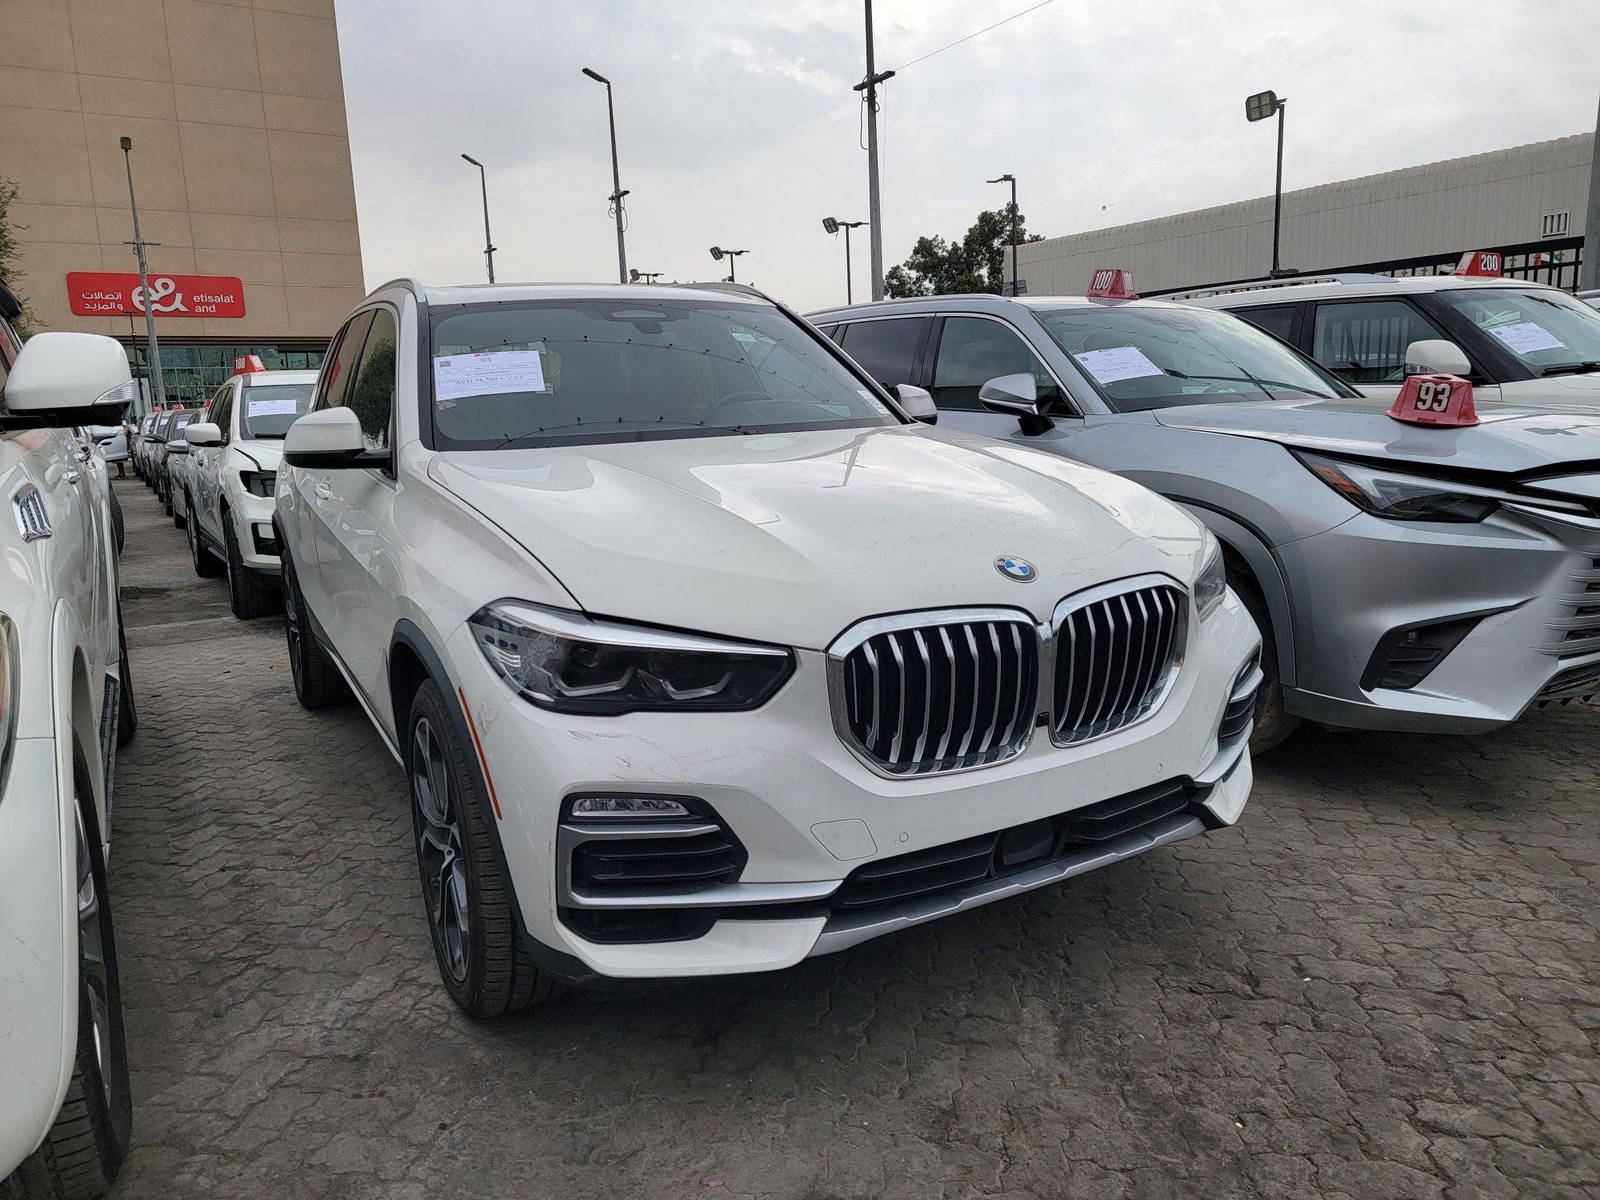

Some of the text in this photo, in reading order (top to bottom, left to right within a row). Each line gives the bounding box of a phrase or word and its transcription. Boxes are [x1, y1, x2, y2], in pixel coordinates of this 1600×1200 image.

[1481, 254, 1498, 271] 200
[1093, 271, 1112, 290] 100
[82, 291, 122, 300] اتصالات
[193, 293, 235, 303] etisalat
[194, 303, 216, 313] and
[1416, 382, 1451, 412] 93
